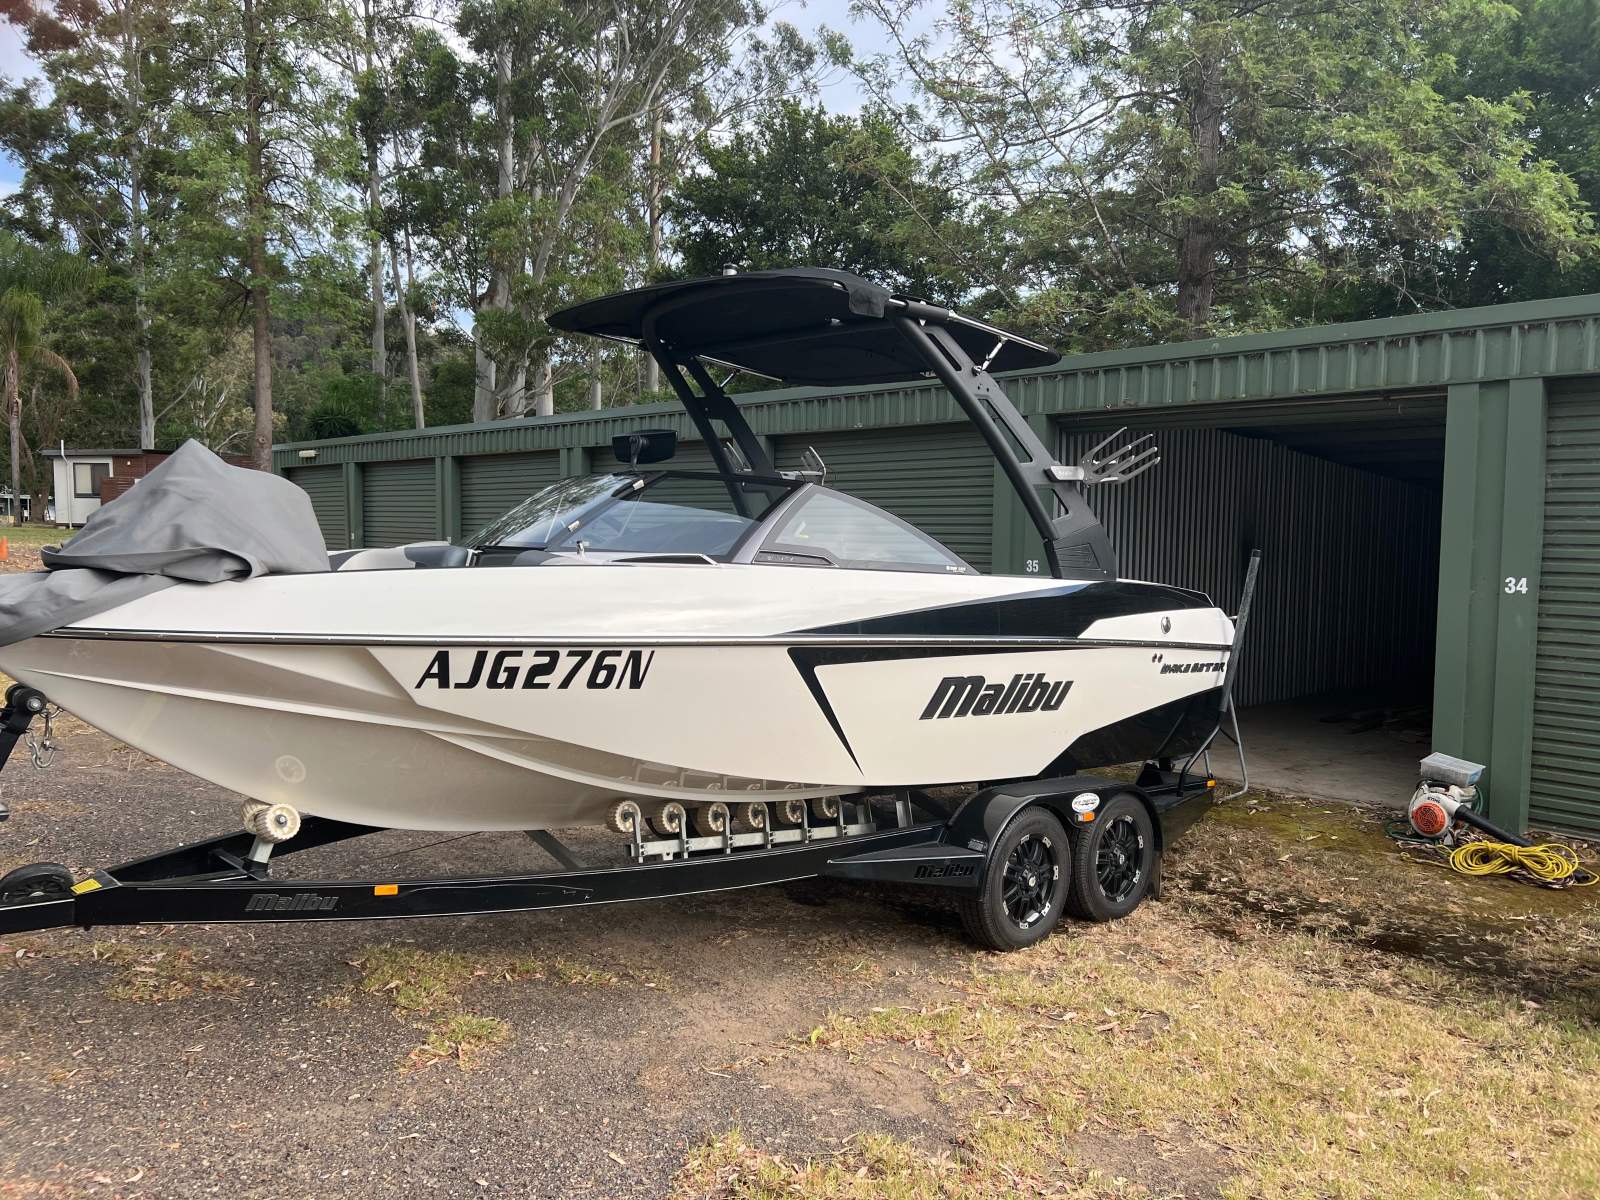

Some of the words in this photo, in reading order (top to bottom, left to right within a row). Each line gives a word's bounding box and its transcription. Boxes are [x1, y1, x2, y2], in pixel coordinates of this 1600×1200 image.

[1026, 560, 1039, 573] 35
[1504, 576, 1529, 595] 34
[414, 650, 656, 690] AJG276N
[919, 673, 1075, 720] Malibu
[913, 862, 975, 879] Malibu
[245, 893, 340, 912] Malibu
